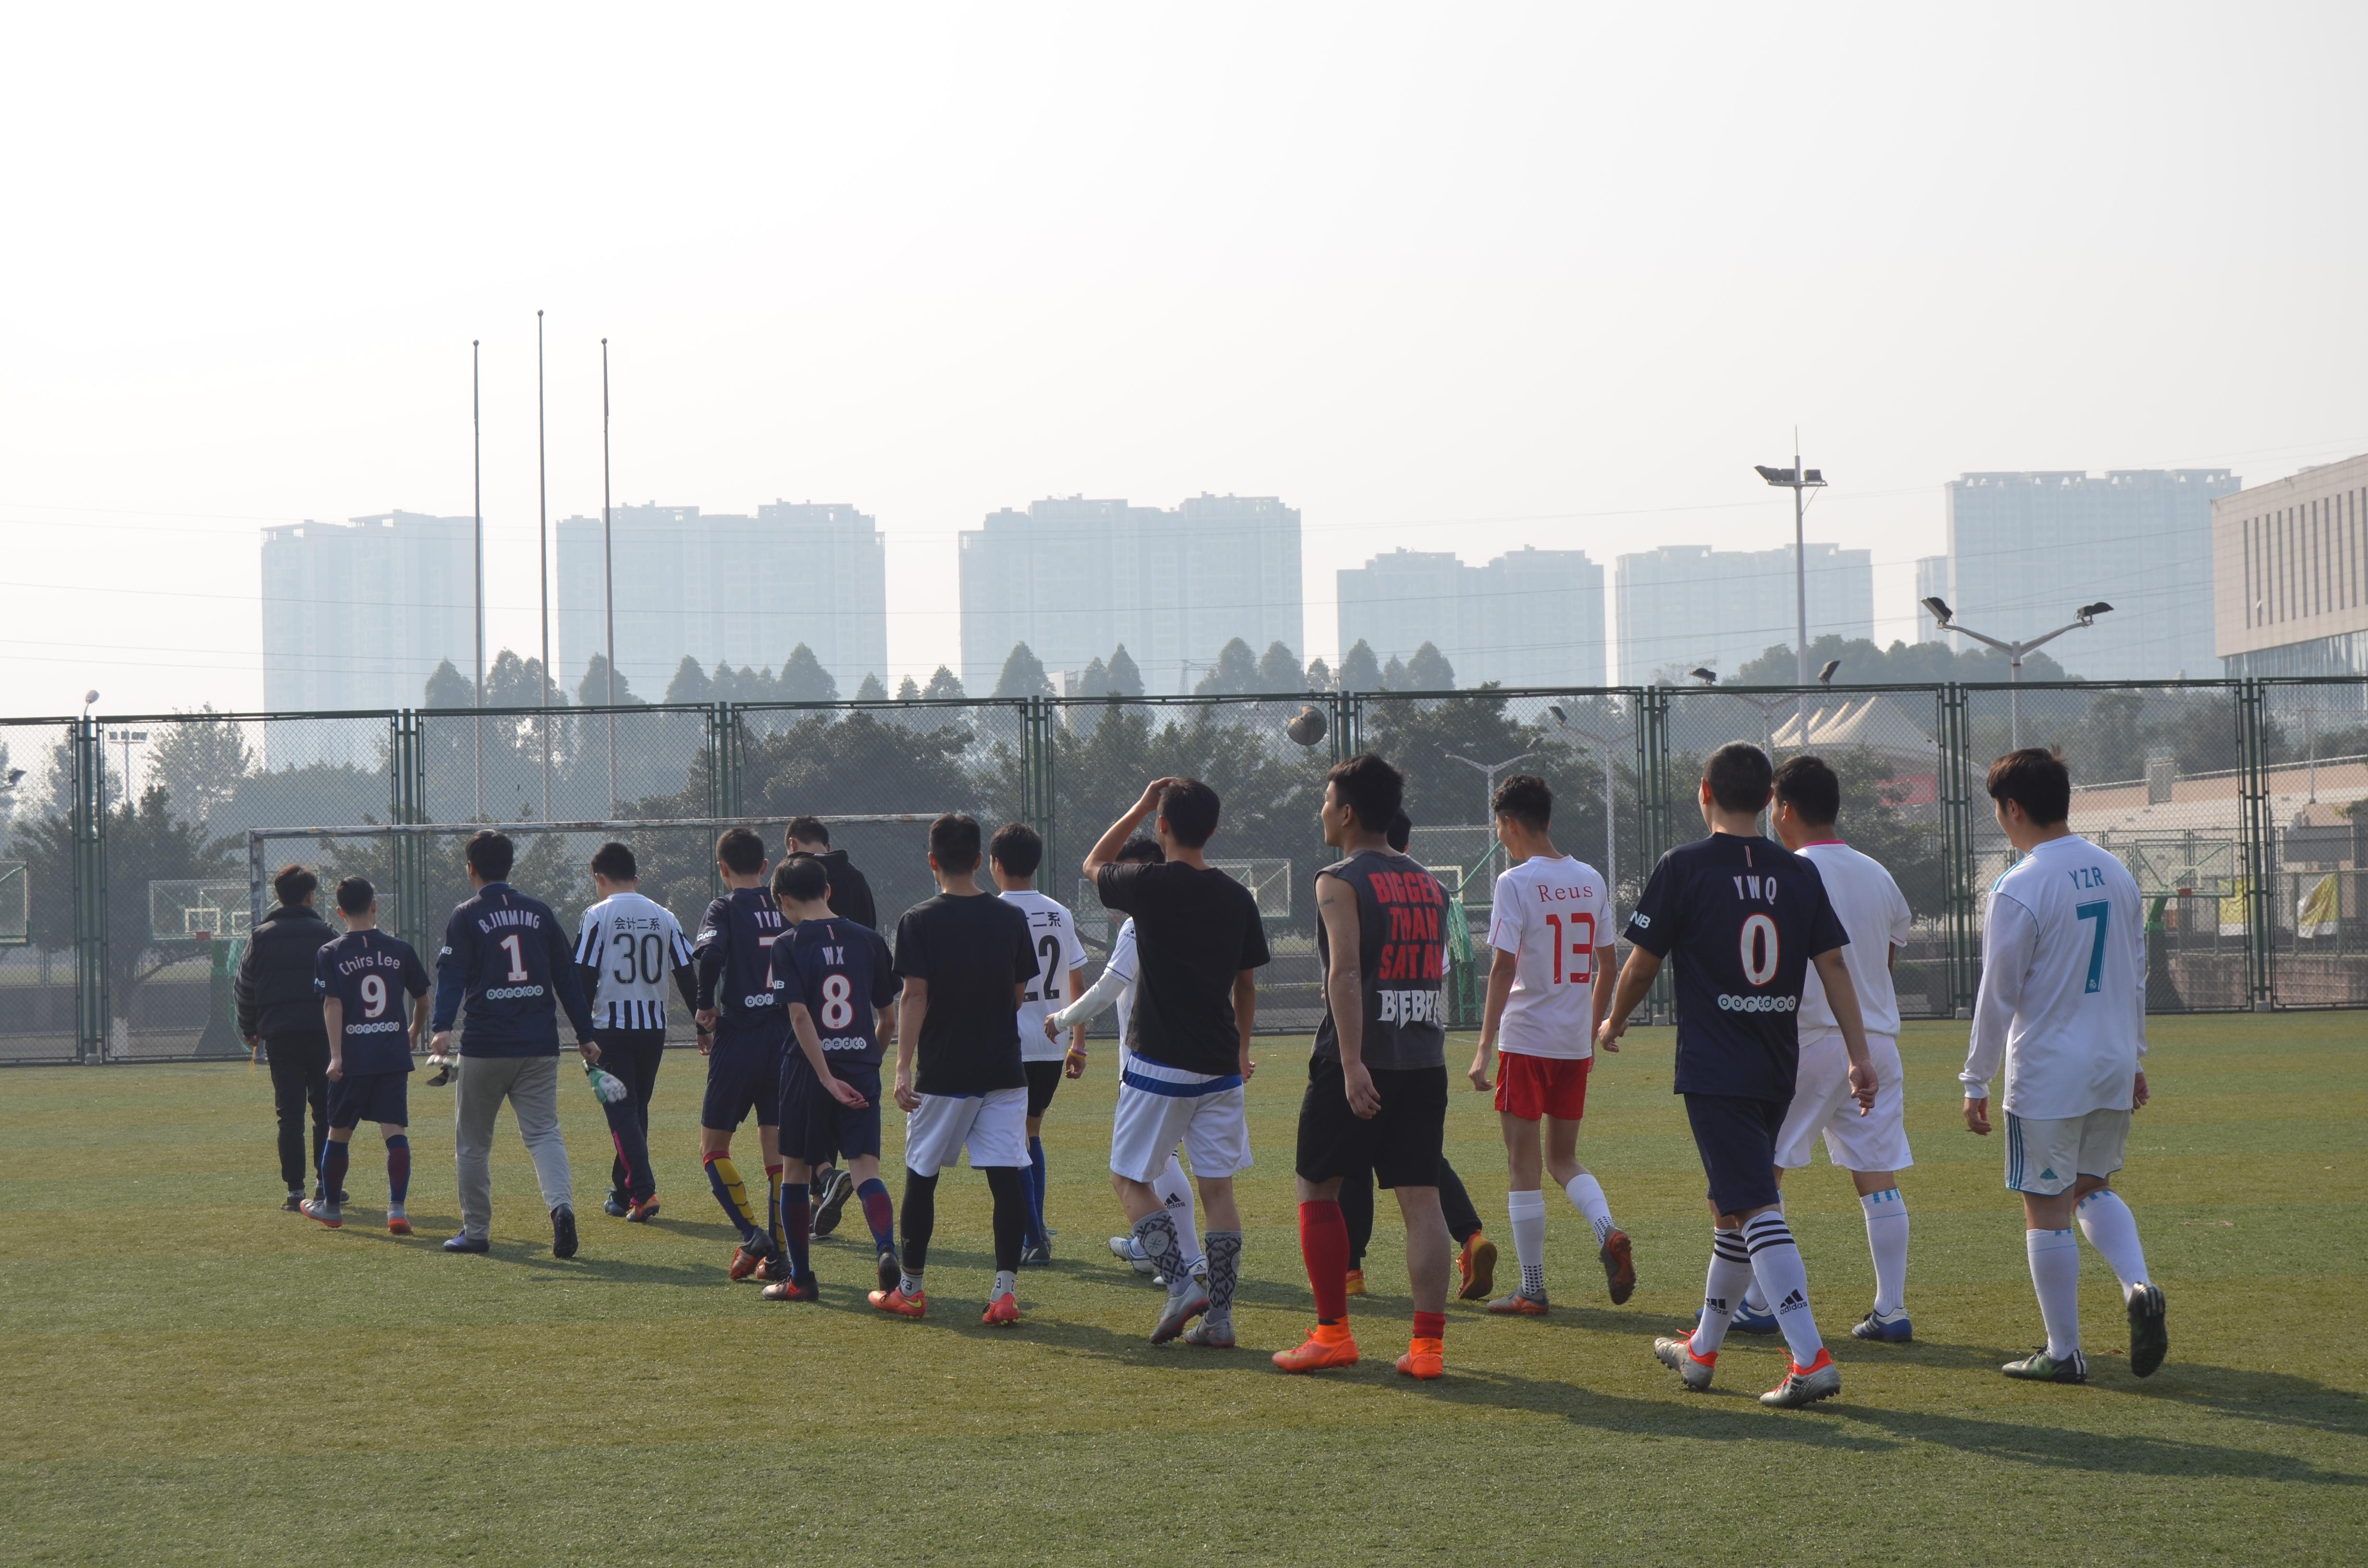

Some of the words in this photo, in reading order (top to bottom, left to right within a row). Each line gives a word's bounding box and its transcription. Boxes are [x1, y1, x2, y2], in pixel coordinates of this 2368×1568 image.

[1368, 871, 1443, 906] BIGGER
[1536, 884, 1593, 902] Reus
[1733, 876, 1777, 905] YWQ
[2068, 866, 2106, 890] YZR
[478, 910, 540, 933] B.JINMING
[614, 917, 660, 931] 会计二系
[754, 911, 781, 928] YYH
[1026, 912, 1061, 927] 二系
[1389, 906, 1439, 941] THAN
[500, 934, 528, 981] 1
[612, 931, 664, 985] 30
[1379, 943, 1443, 980] SATAN
[1546, 912, 1596, 984] 13
[1739, 913, 1780, 986] 0
[2076, 898, 2111, 994] 7
[339, 956, 373, 975] Chirs
[378, 951, 400, 969] Lee
[361, 974, 386, 1018] 9
[821, 974, 853, 1029] 8
[346, 1022, 400, 1034] ooredoo
[1780, 1301, 1808, 1315] adidas
